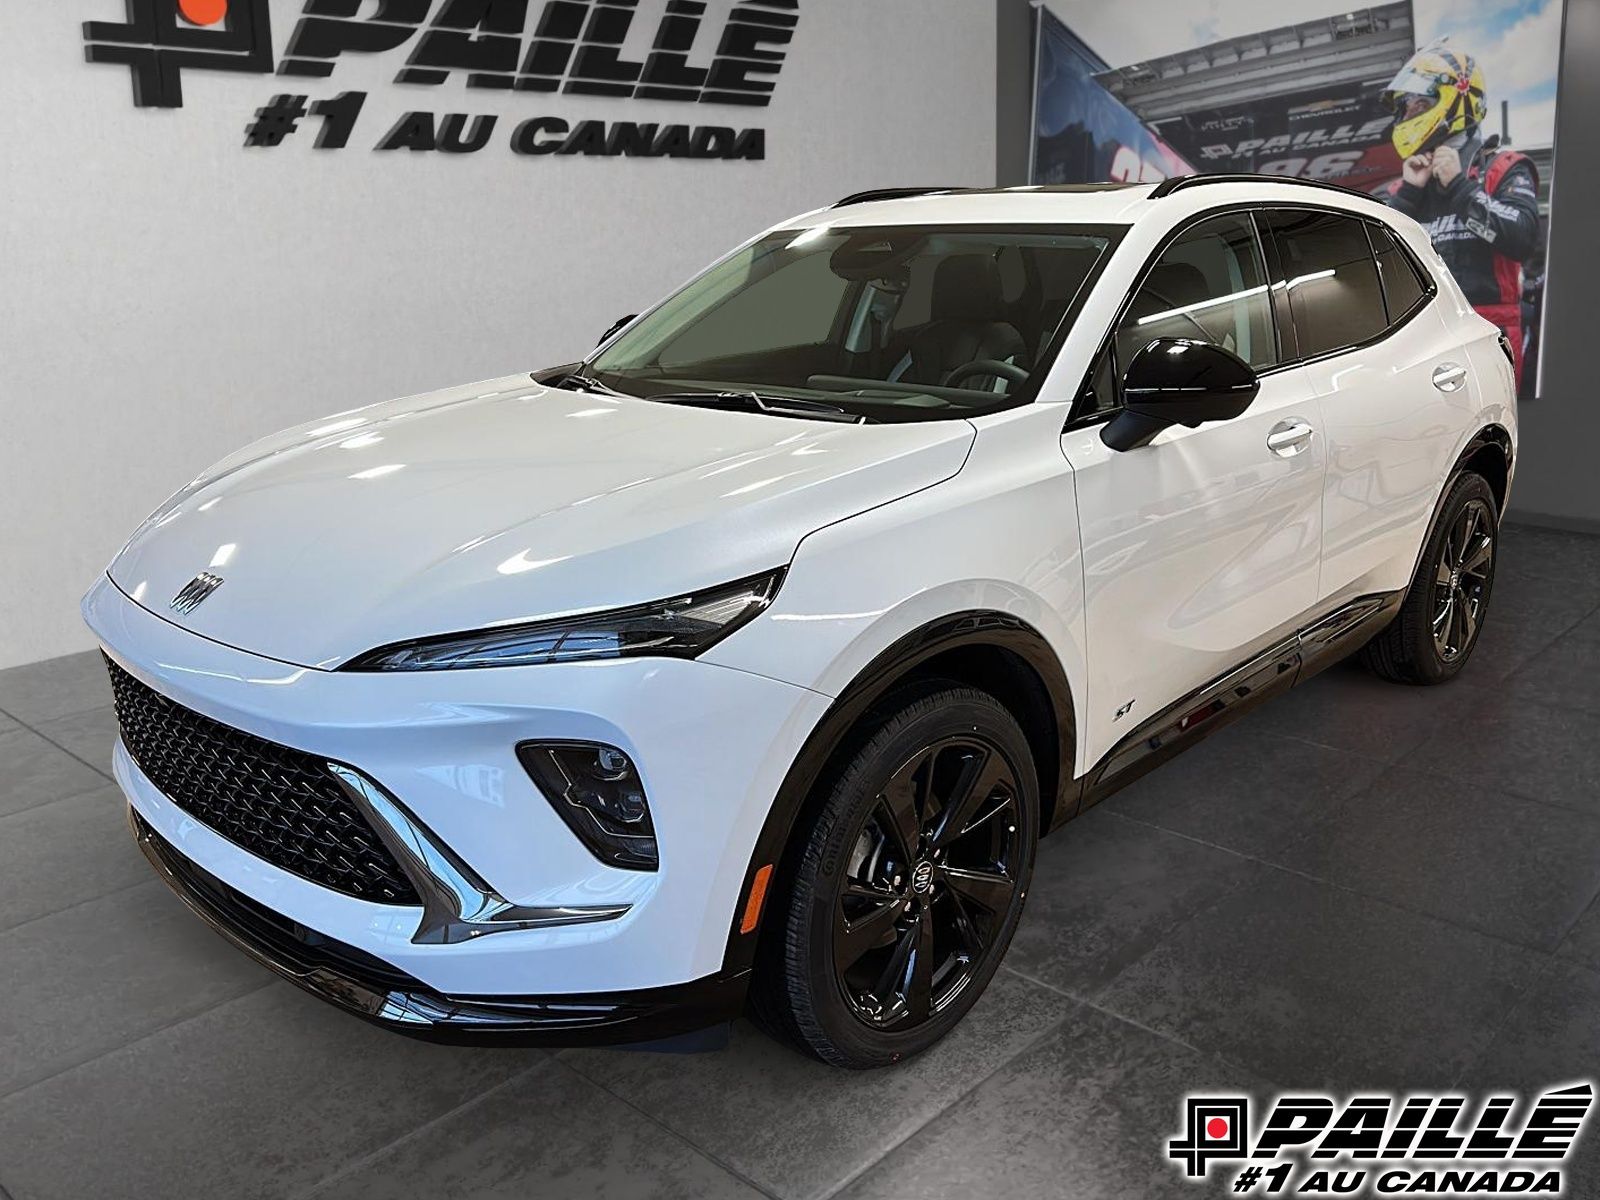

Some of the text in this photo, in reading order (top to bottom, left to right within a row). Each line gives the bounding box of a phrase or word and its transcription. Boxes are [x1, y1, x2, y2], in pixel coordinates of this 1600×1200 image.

[243, 91, 765, 160] #1 AU CANADA
